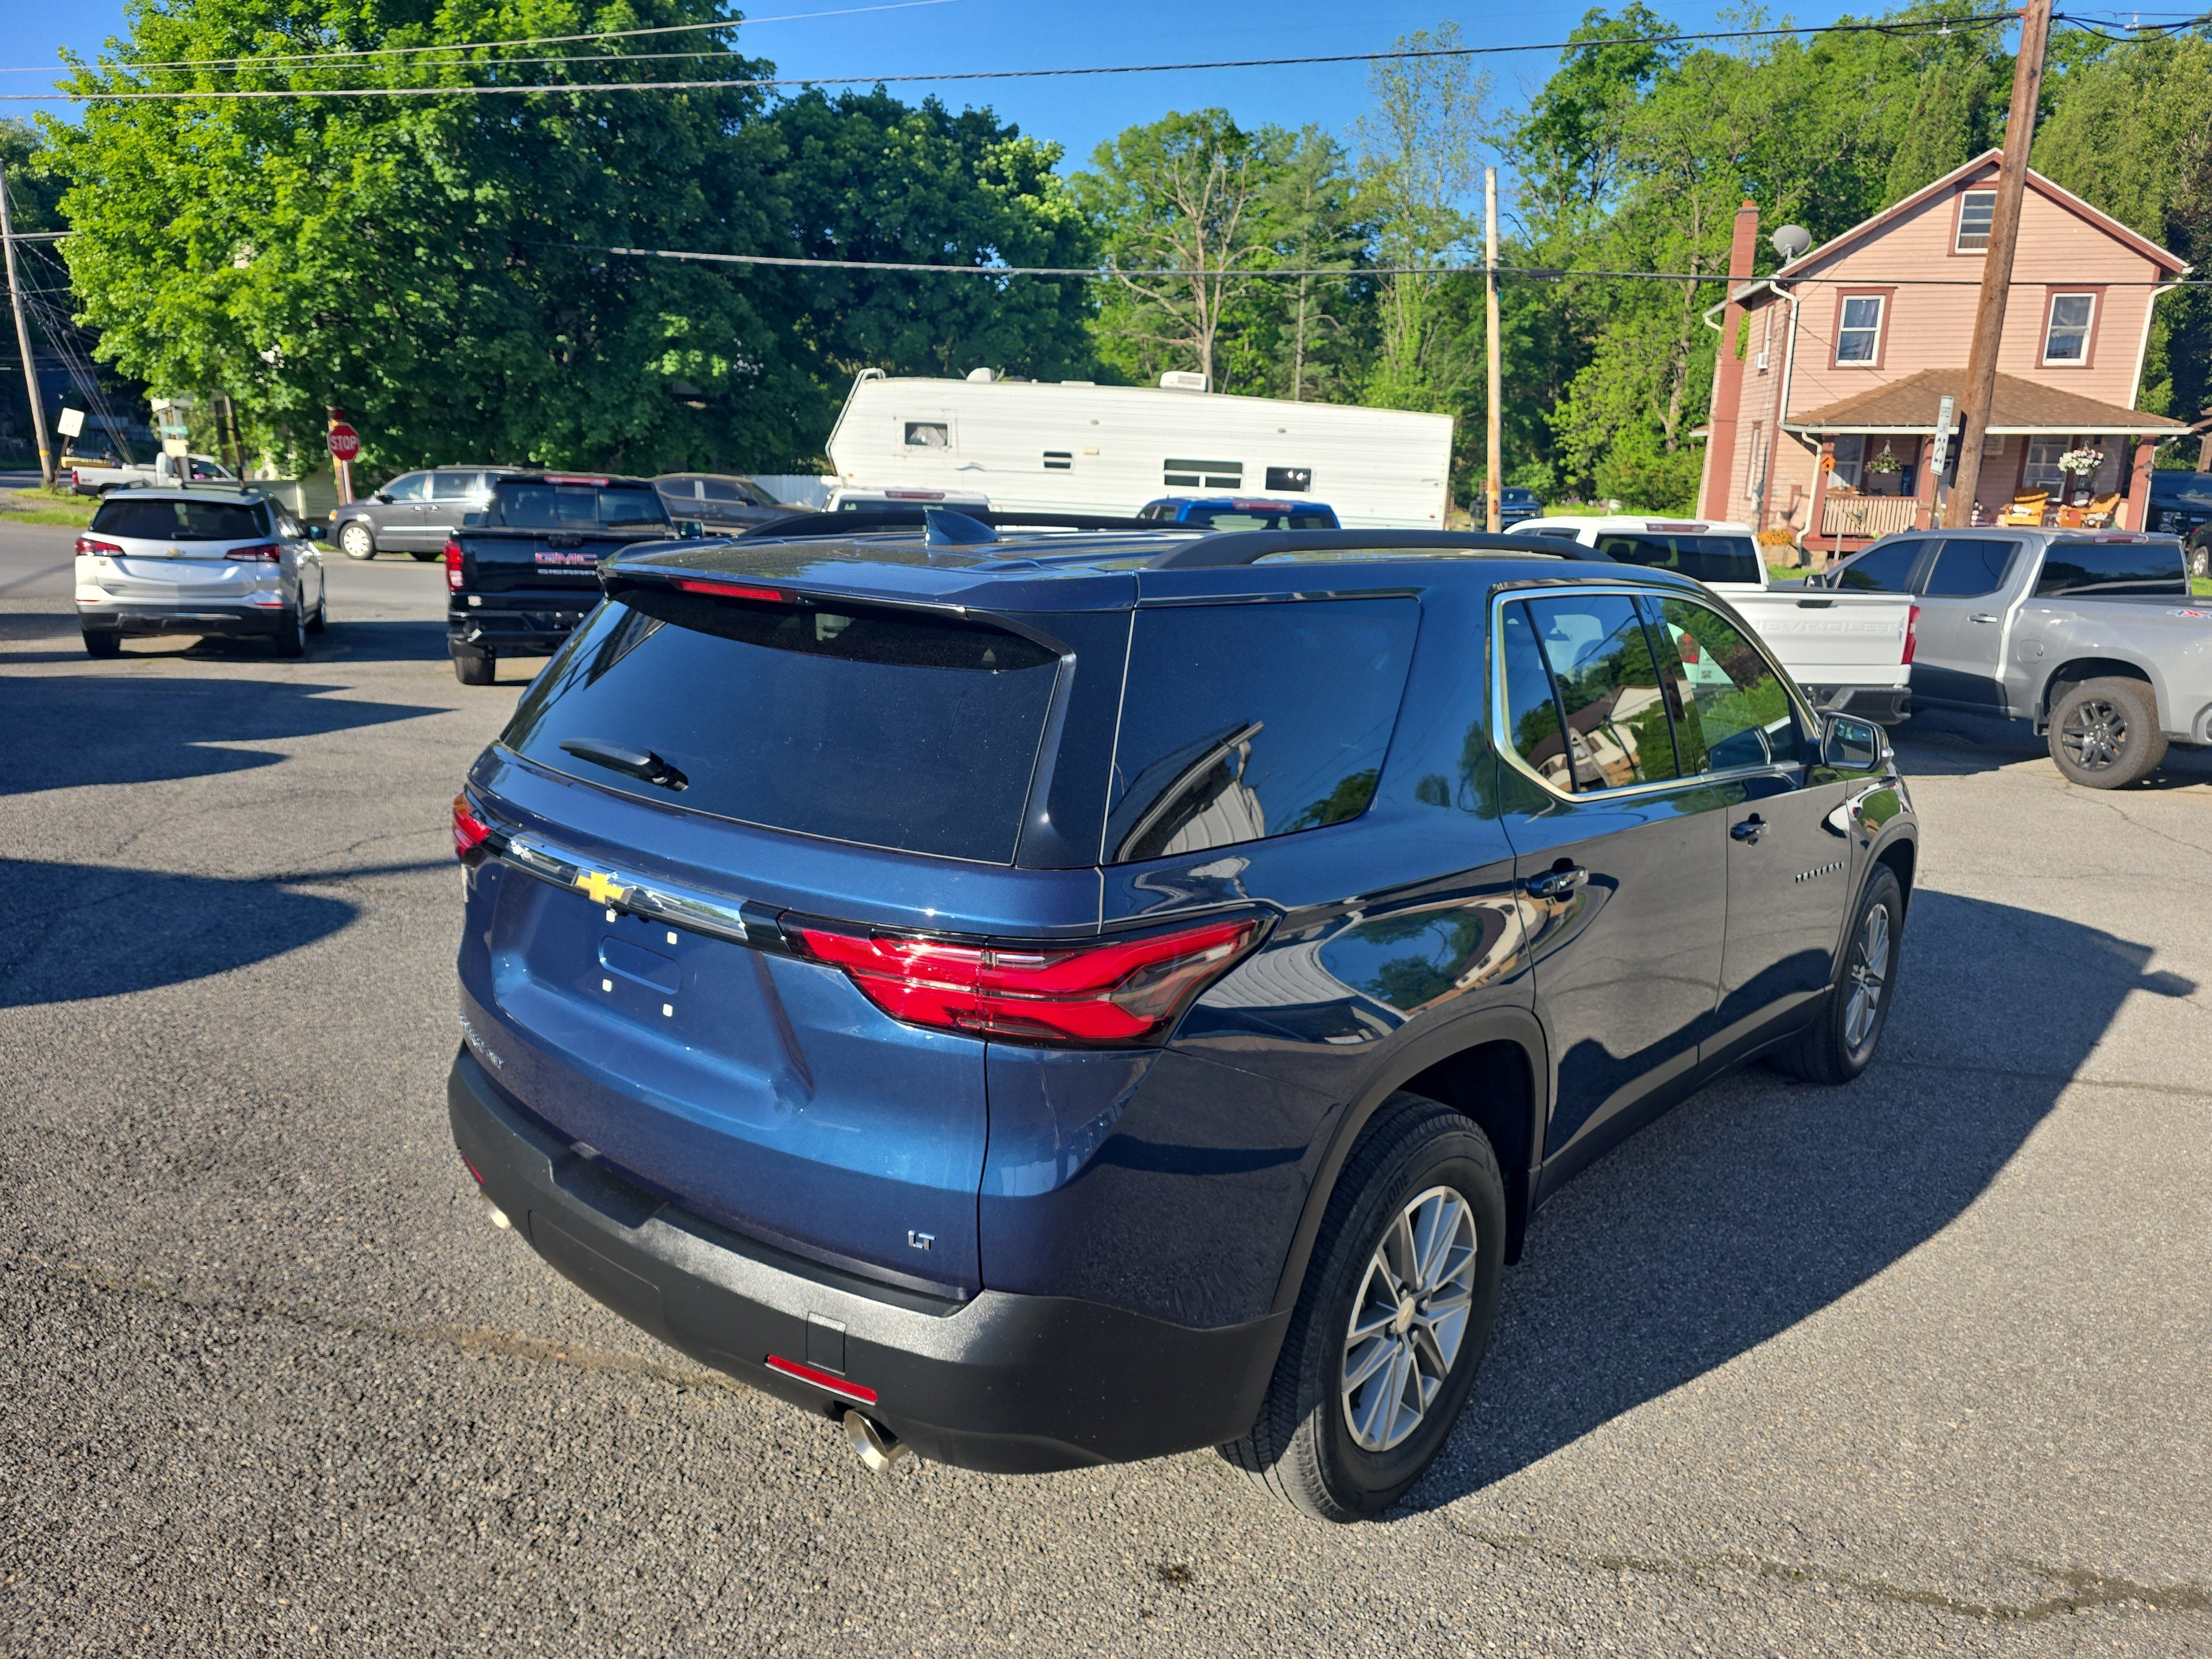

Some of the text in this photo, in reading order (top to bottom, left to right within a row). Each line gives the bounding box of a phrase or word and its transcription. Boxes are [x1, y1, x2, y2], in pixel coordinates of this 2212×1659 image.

[330, 435, 357, 451] STOP
[535, 552, 597, 564] GMC
[908, 1230, 936, 1251] LT
